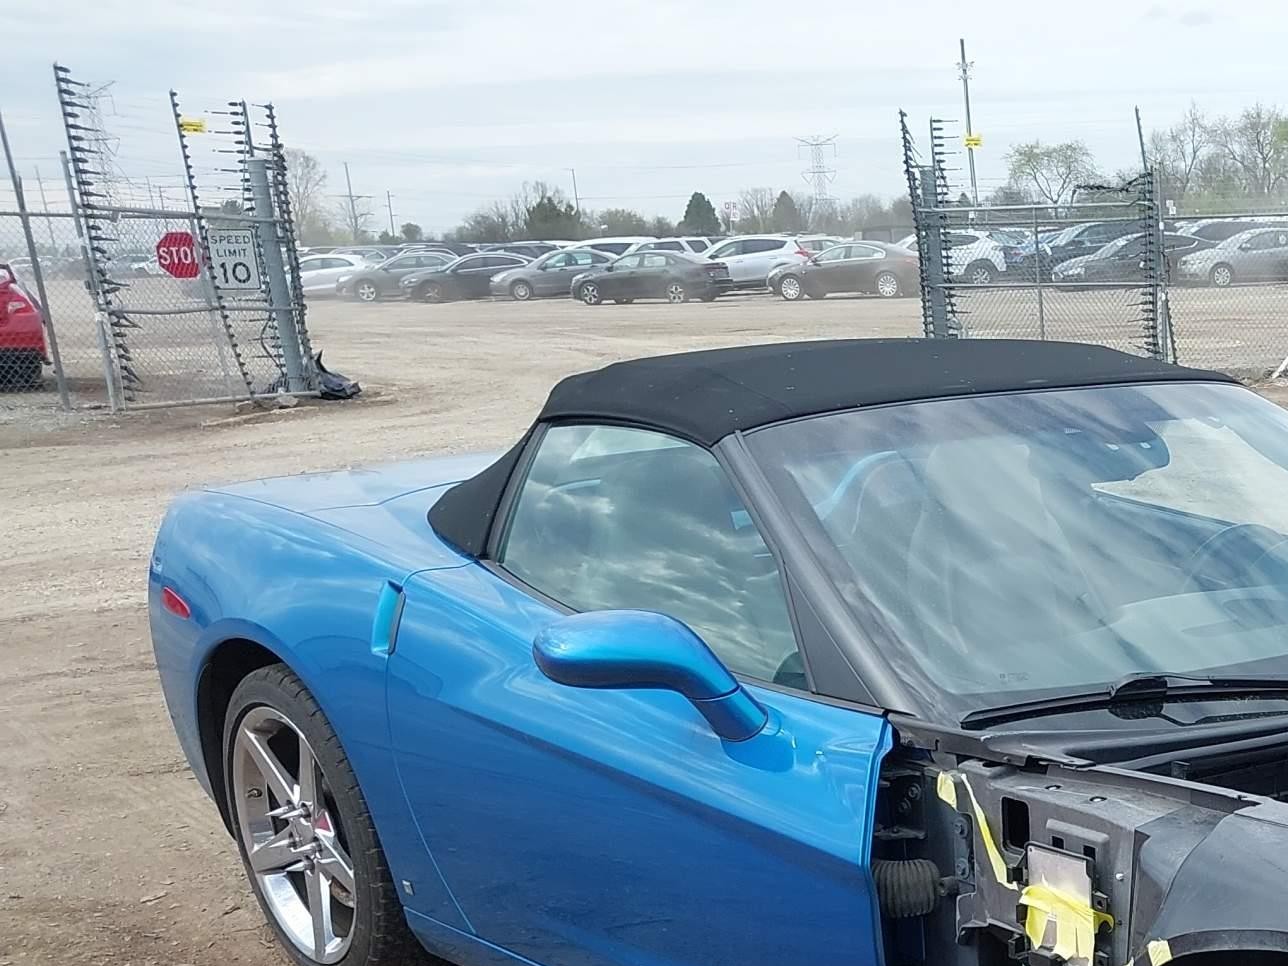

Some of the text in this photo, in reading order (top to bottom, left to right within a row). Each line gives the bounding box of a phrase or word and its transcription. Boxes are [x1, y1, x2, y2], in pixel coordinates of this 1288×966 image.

[210, 235, 251, 245] SPEED
[216, 248, 247, 258] LIMIT
[219, 262, 252, 284] 10
